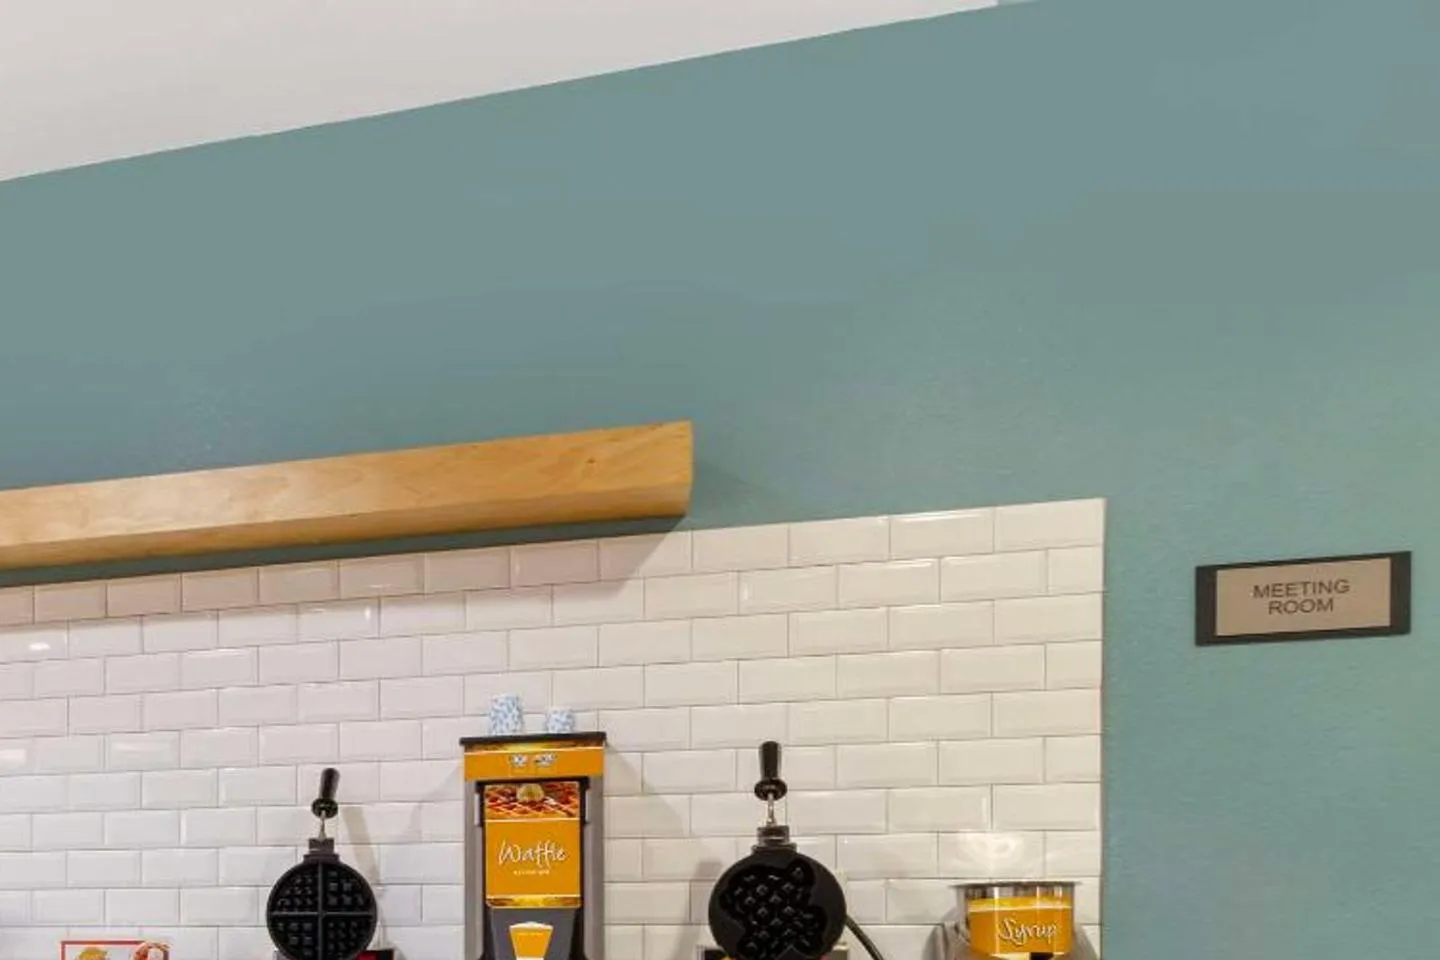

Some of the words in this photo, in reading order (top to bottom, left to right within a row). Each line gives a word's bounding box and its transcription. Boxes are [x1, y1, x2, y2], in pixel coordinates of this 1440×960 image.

[1252, 578, 1351, 600] MEETING
[1268, 597, 1335, 616] ROOM
[498, 840, 568, 869] Waffle
[999, 917, 1058, 946] Syrup
